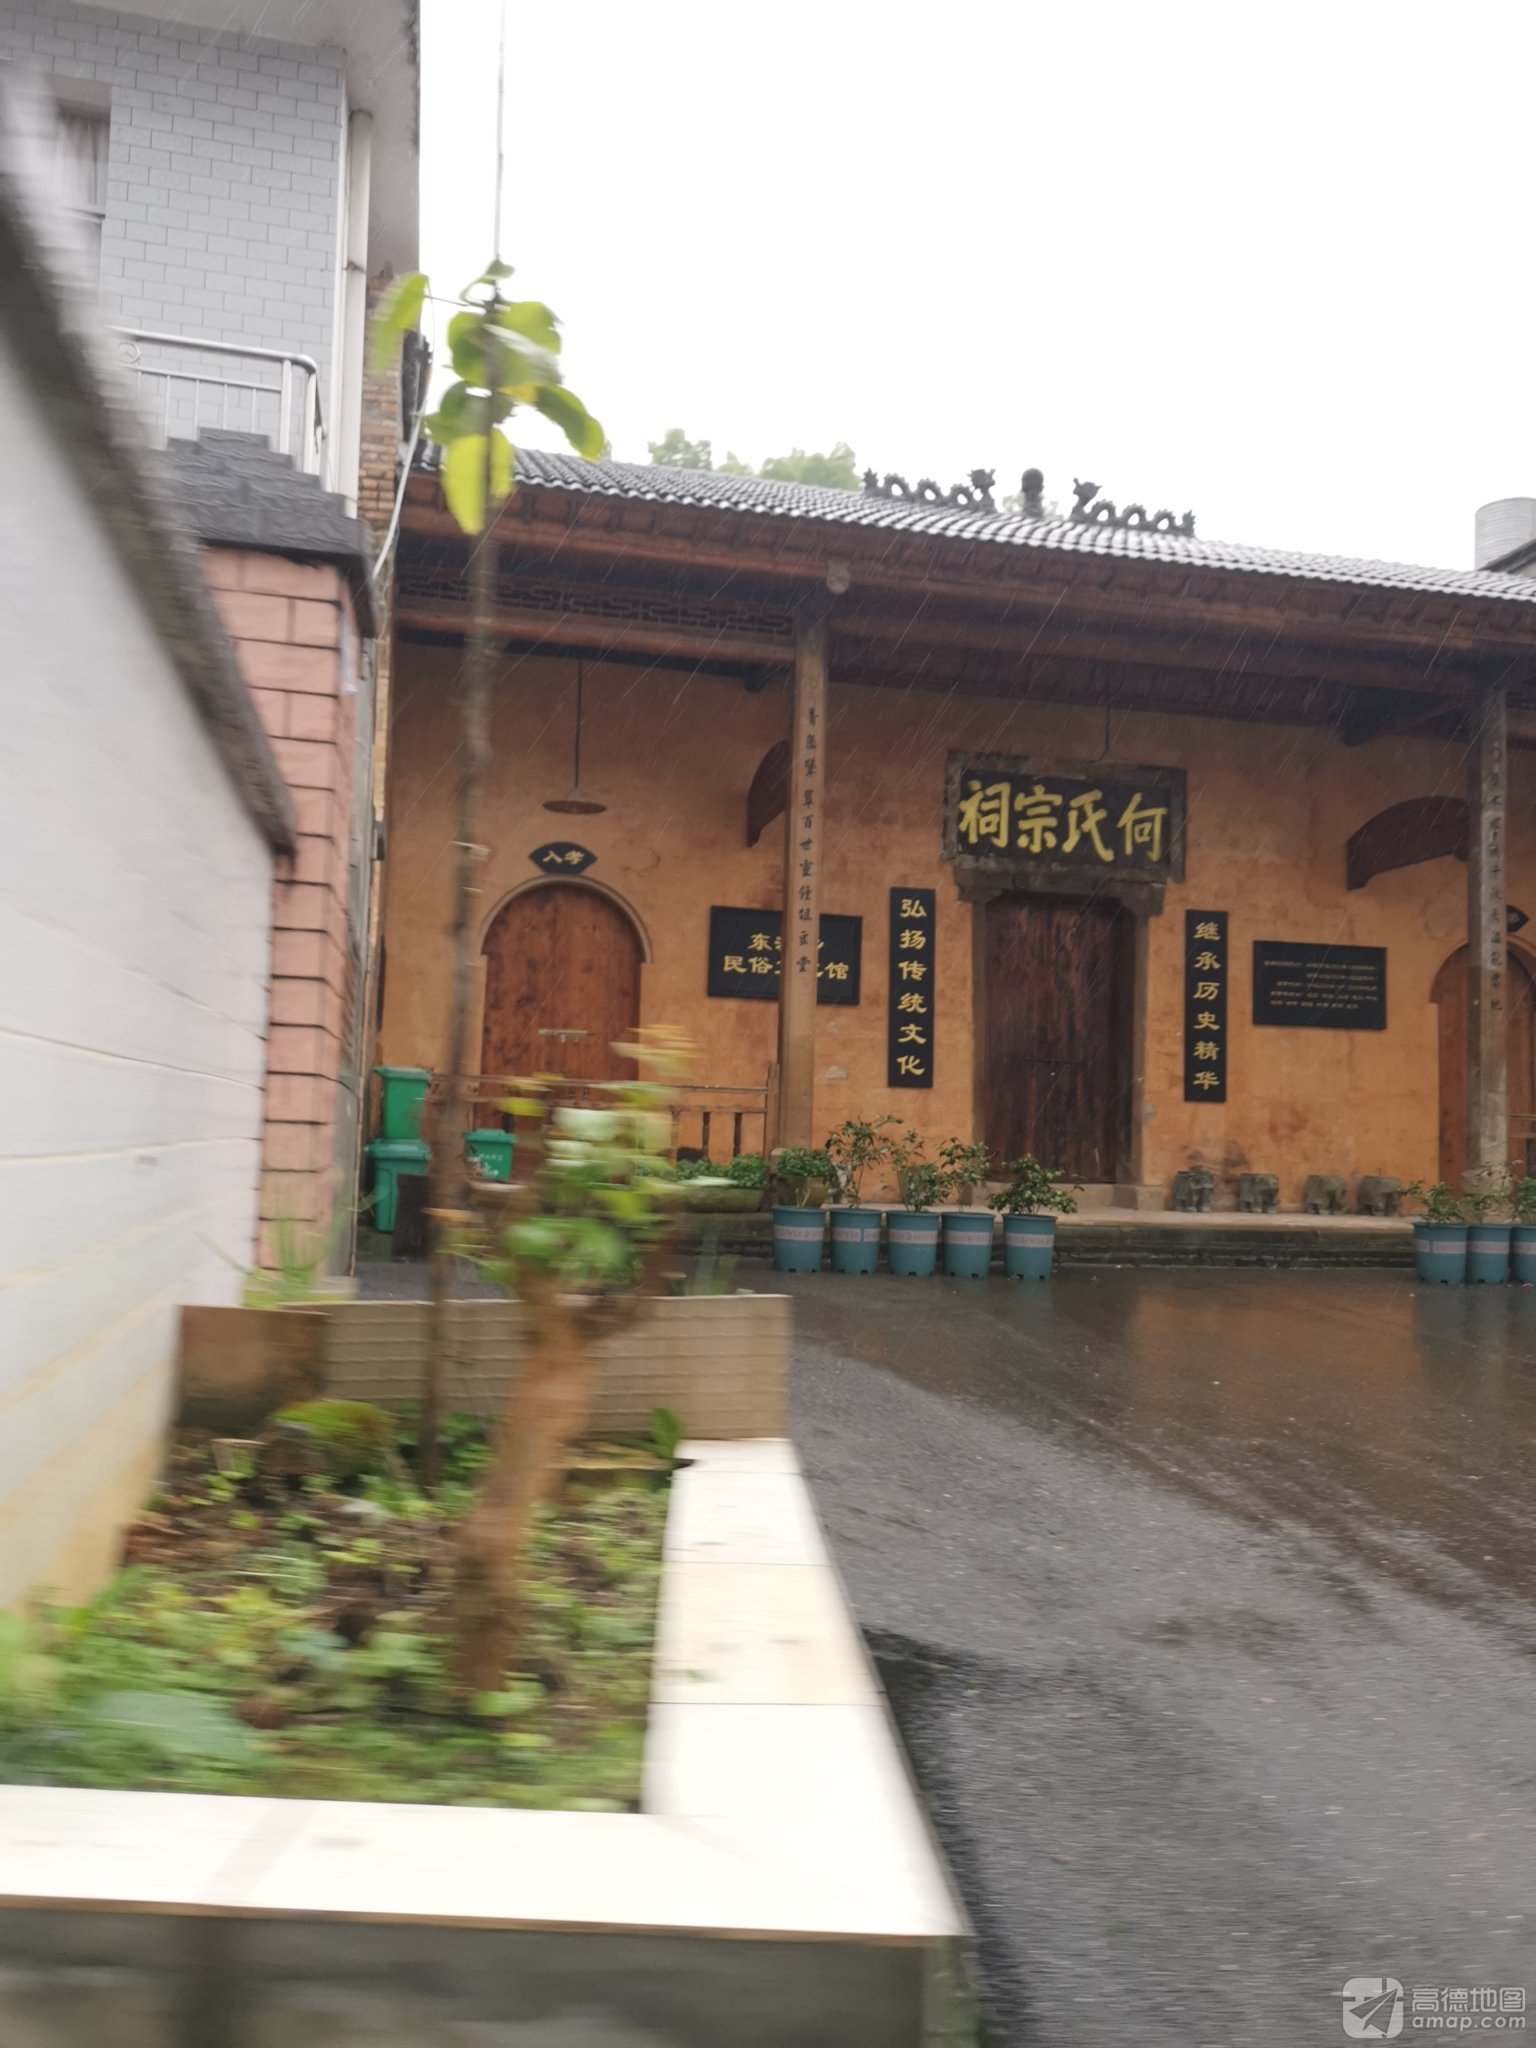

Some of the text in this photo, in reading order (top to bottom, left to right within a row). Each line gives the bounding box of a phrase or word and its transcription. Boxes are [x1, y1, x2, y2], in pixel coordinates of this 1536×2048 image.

[957, 779, 1168, 863] 何氏宗祠
[723, 954, 850, 980] 民俗馆
[896, 898, 928, 1076] 弘扬传统文化
[1193, 921, 1221, 1091] 继承历史精华
